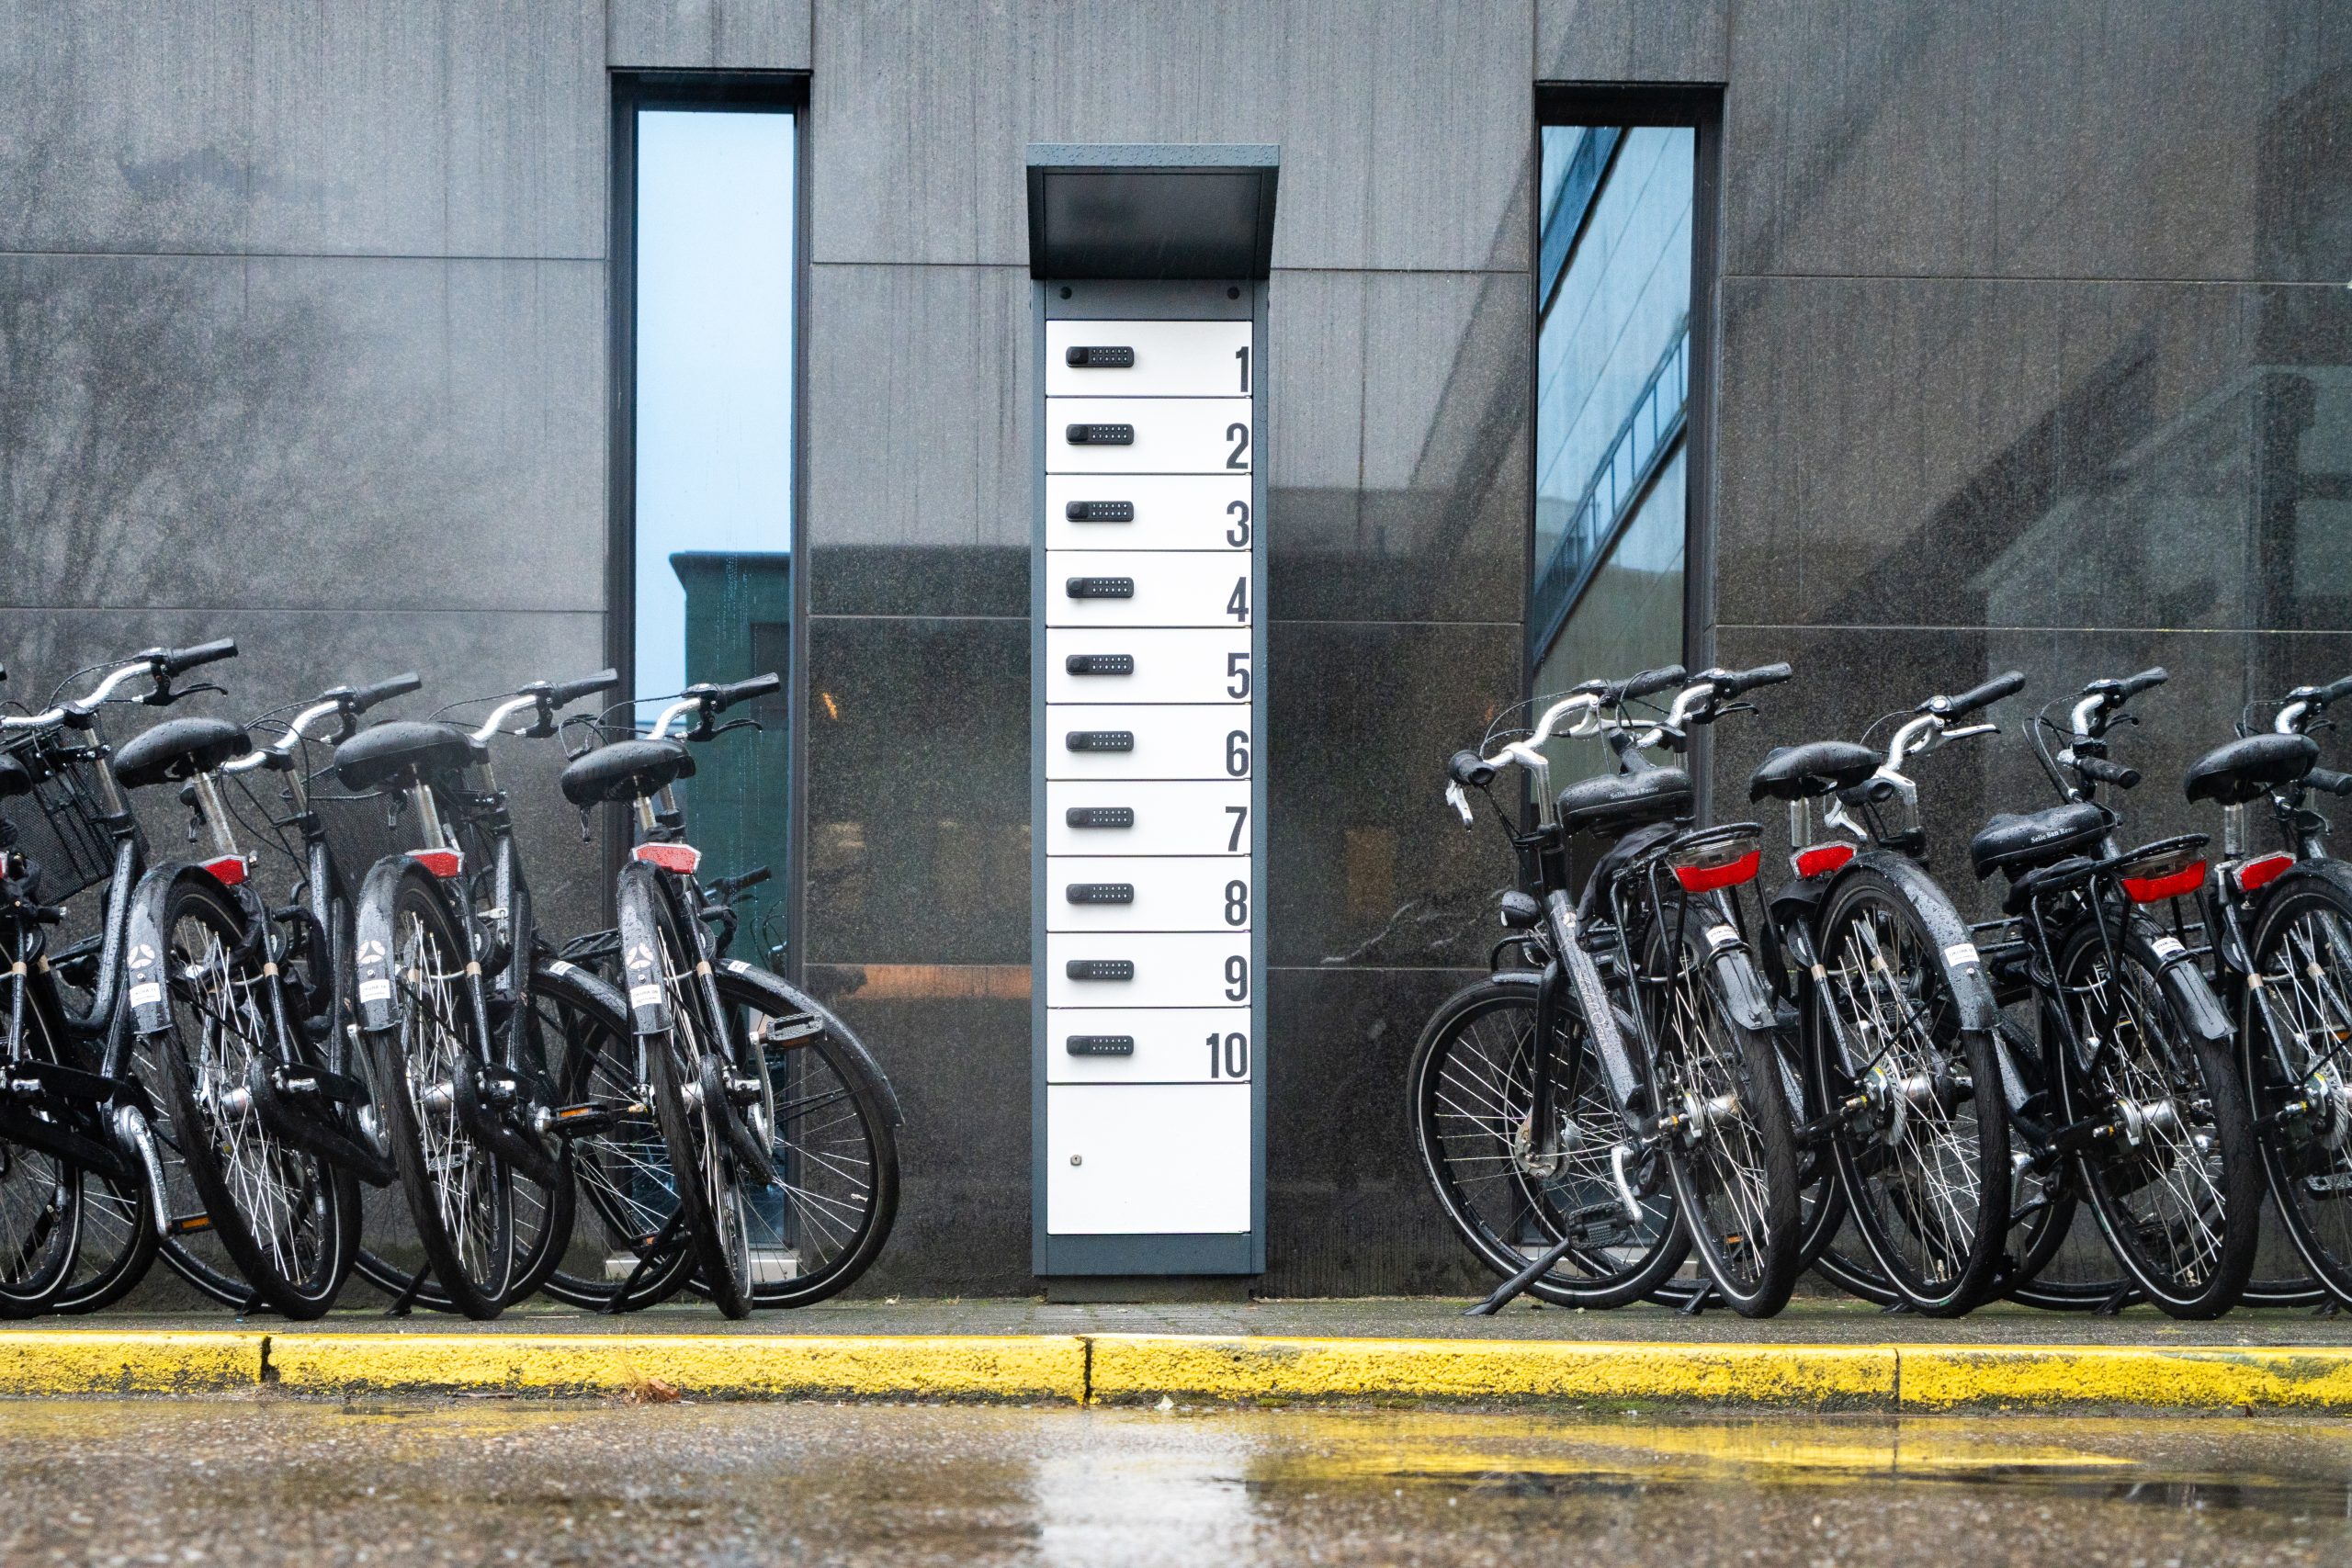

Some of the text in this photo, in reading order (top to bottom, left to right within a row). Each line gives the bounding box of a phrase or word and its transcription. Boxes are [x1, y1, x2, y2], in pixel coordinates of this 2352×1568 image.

[1235, 346, 1250, 392] 1
[1226, 423, 1250, 469] 2
[1227, 500, 1250, 547] 3
[1227, 577, 1250, 623] 4
[1227, 652, 1250, 699] 5
[1226, 729, 1250, 777] 6
[1610, 791, 1625, 800] Selle
[1225, 806, 1248, 852] 7
[2030, 827, 2078, 843] Selle San Remo
[1225, 879, 1248, 926] 8
[1225, 955, 1248, 1002] 9
[1205, 1032, 1248, 1078] 10
